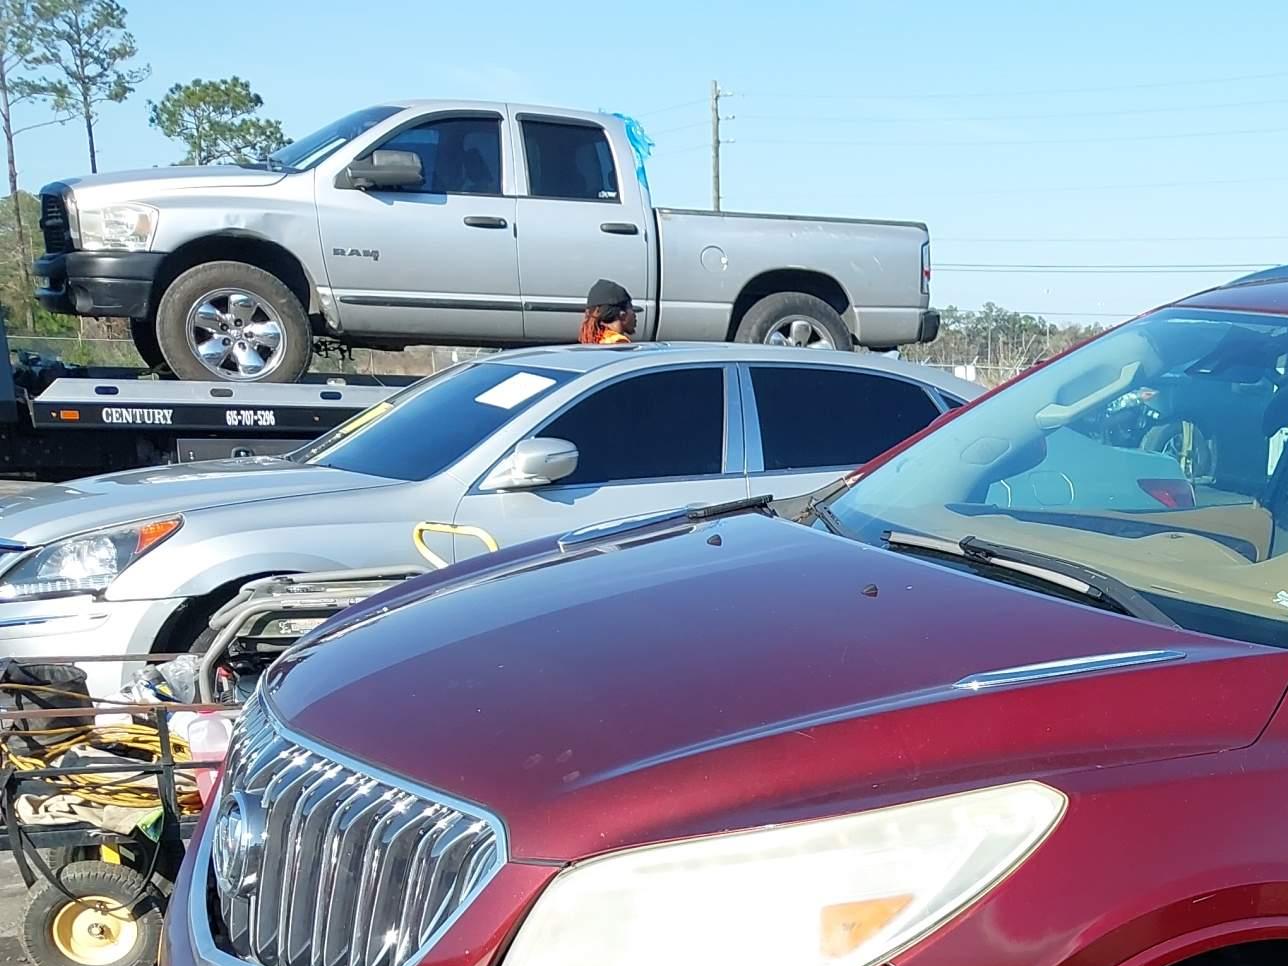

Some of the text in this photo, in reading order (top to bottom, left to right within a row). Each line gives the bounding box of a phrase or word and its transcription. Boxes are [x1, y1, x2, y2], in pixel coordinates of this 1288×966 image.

[333, 248, 380, 261] RAM
[102, 407, 276, 426] CENTURY 615-707-5296
